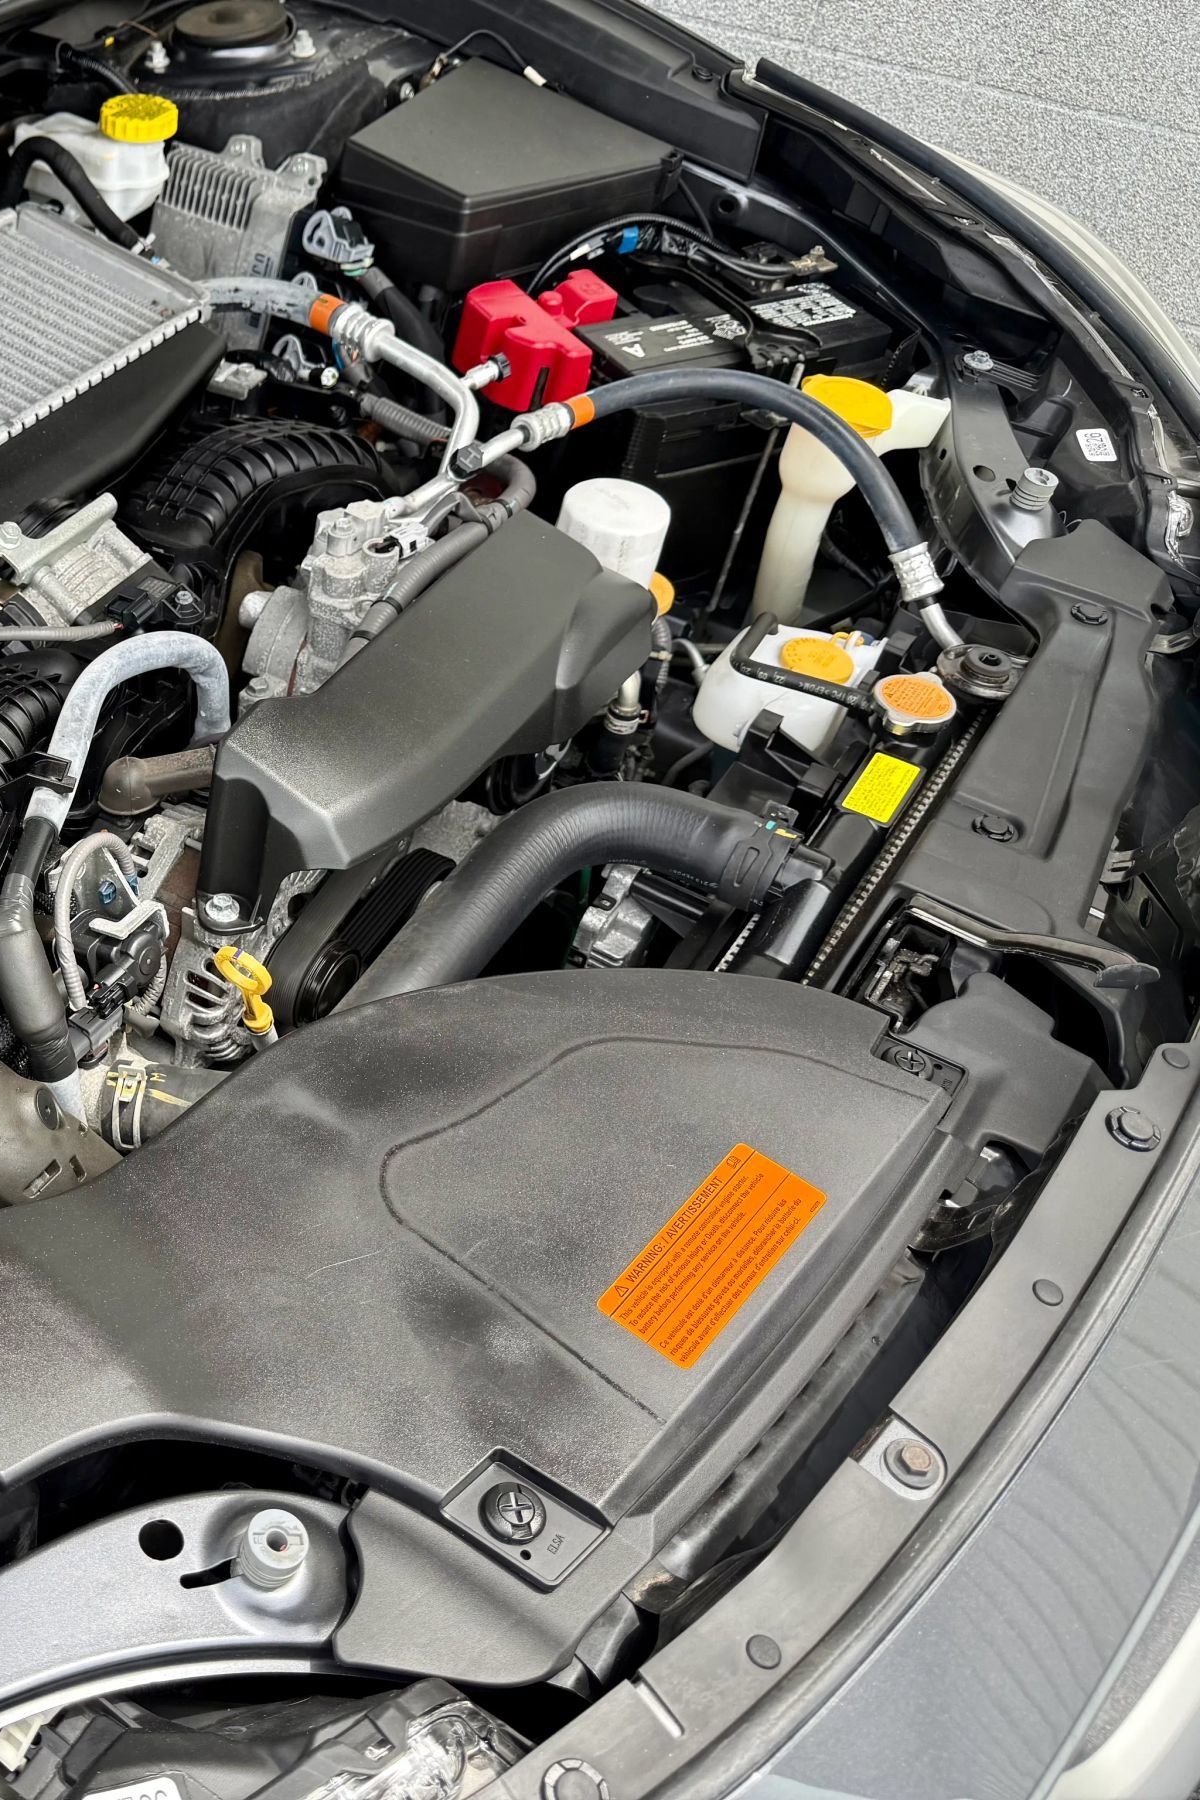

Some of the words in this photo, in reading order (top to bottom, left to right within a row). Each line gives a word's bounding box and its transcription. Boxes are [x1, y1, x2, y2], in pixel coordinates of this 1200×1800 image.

[460, 448, 481, 468] H
[776, 1203, 796, 1224] batterie
[791, 1196, 802, 1206] du
[625, 1240, 666, 1284] WARNING:
[664, 1175, 723, 1239] AVERTISSEMENT
[772, 1220, 782, 1229] la
[618, 1306, 634, 1321] This
[628, 1288, 649, 1309] vehicle
[644, 1282, 654, 1291] is
[649, 1260, 675, 1287] equipped
[668, 1249, 683, 1263] with
[681, 1228, 701, 1248] remote
[696, 1205, 721, 1231] controlled
[716, 1189, 736, 1209] engine
[730, 1173, 749, 1192] starter.
[628, 1317, 639, 1327] To
[634, 1299, 654, 1320] reduce
[649, 1290, 662, 1302] the
[657, 1280, 670, 1293] risk
[665, 1275, 675, 1284] of
[670, 1256, 691, 1278] serious
[699, 1237, 708, 1245] or
[716, 1195, 743, 1224] disconnect
[738, 1187, 750, 1199] the
[745, 1171, 764, 1191] vehicle
[637, 1313, 659, 1335] battery
[653, 1296, 672, 1316] before
[667, 1269, 697, 1300] performing
[691, 1261, 704, 1274] any
[698, 1242, 718, 1263] service
[714, 1236, 724, 1246] on
[719, 1227, 731, 1239] the
[658, 1337, 670, 1349] Ce
[682, 1307, 695, 1320] est
[709, 1260, 734, 1288] démarreur
[751, 1221, 767, 1236] Pour
[775, 1196, 787, 1208] les
[725, 1277, 735, 1287] ou
[695, 1323, 712, 1341] avant
[729, 1286, 742, 1299] des
[737, 1267, 758, 1289] travaux
[774, 1234, 785, 1245] sur
[711, 1284, 731, 1305] graves
[689, 1301, 715, 1329] blessures
[684, 1325, 695, 1336] de
[667, 1332, 690, 1357] risques
